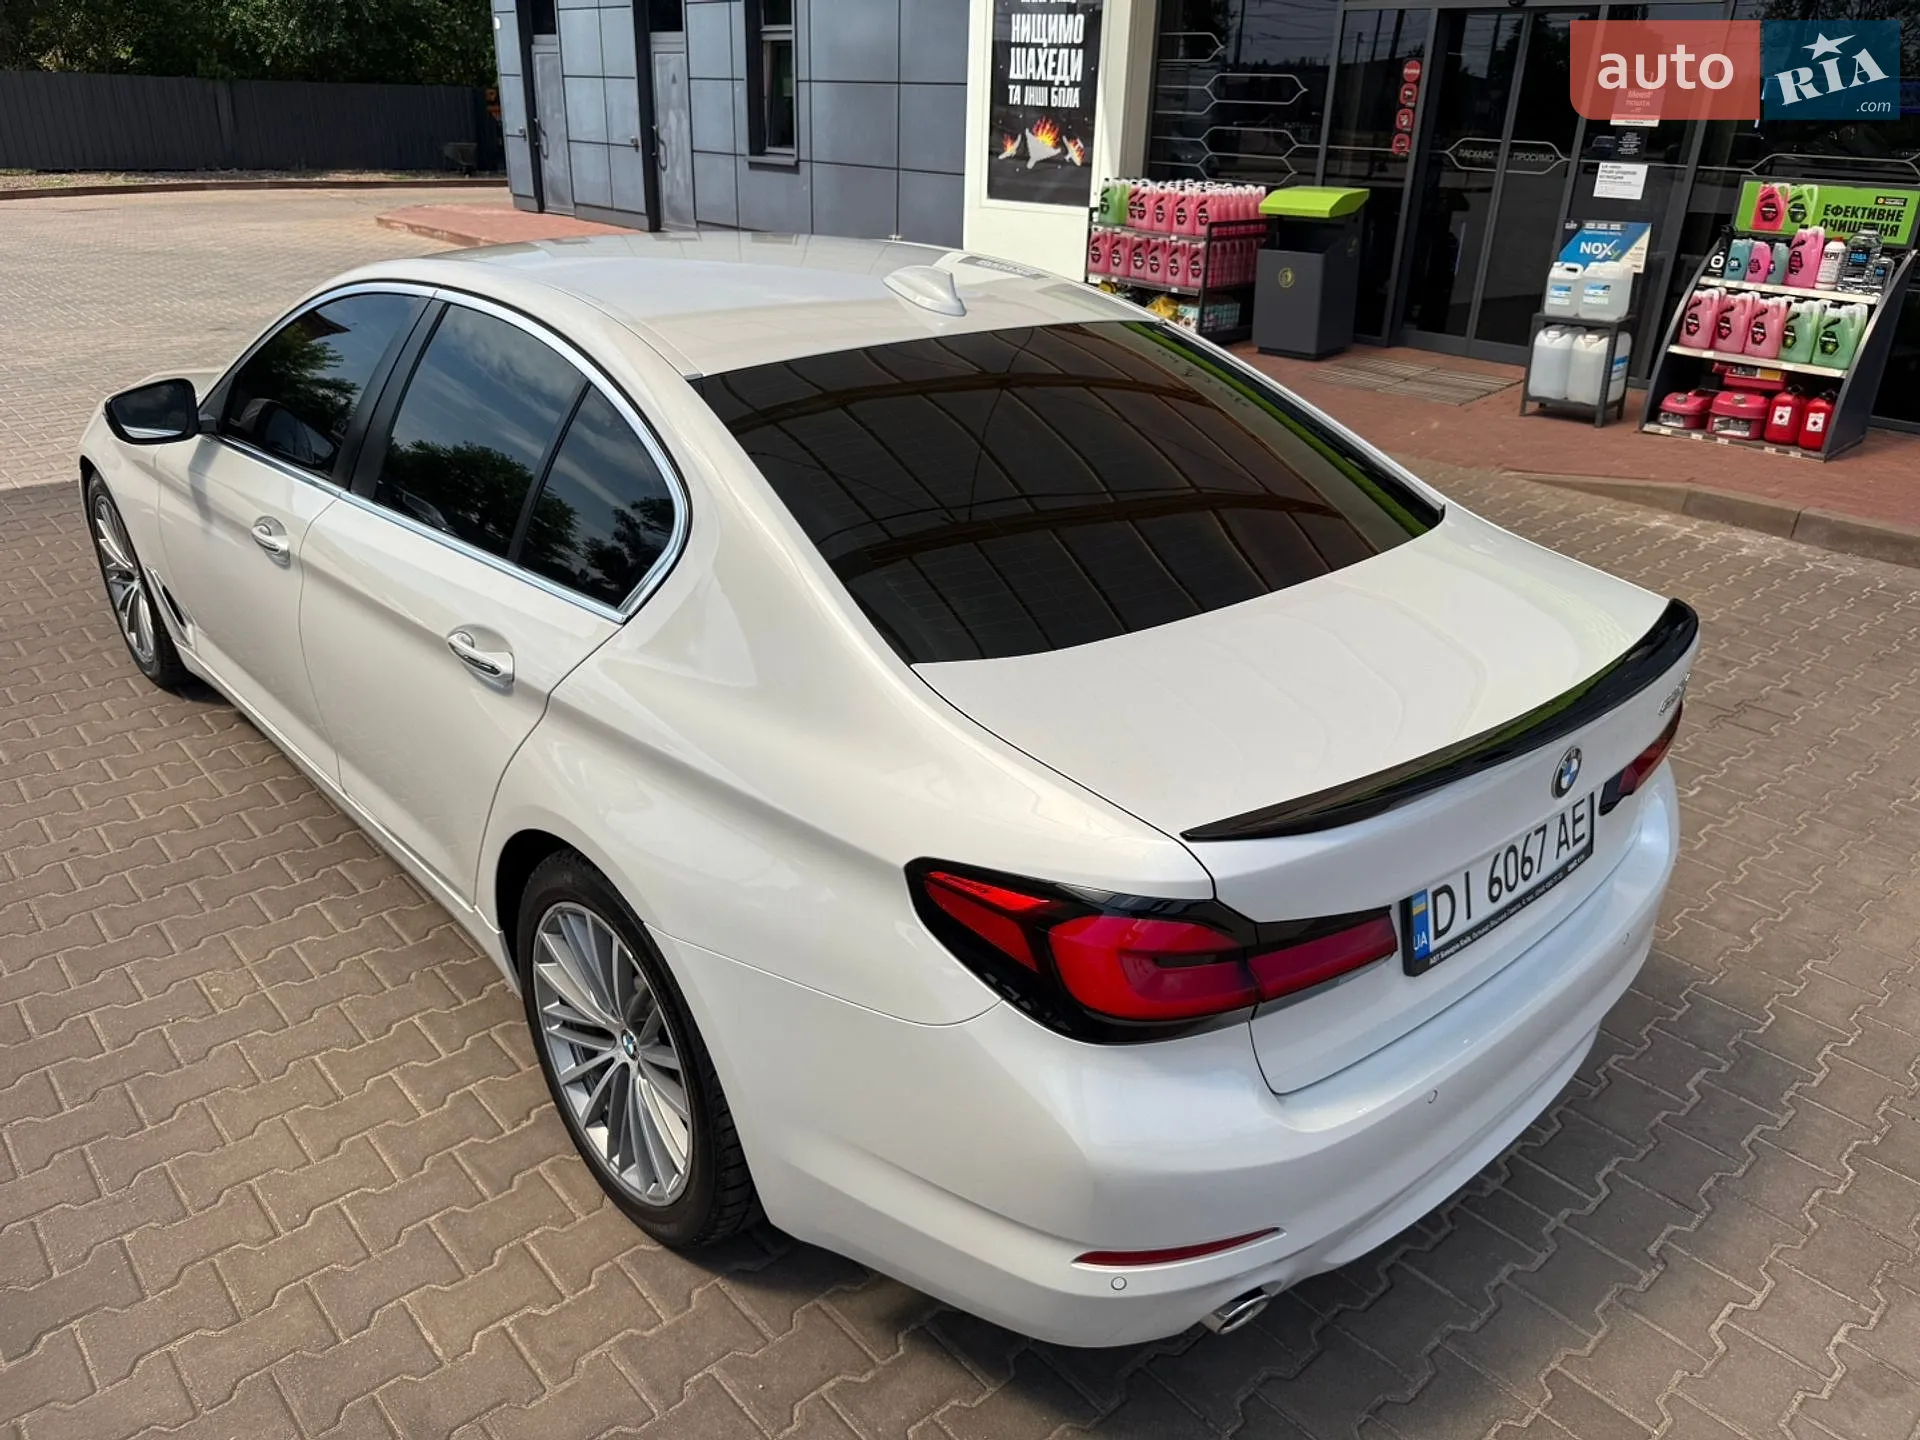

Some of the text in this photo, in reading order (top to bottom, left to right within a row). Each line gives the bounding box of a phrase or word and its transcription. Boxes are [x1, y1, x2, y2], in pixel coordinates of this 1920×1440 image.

[1010, 13, 1085, 48] НИЩИМО
[1008, 47, 1084, 86] ШАХЕДИ
[1008, 84, 1081, 108] ТА ІНШІ БПЛА
[1513, 151, 1555, 163] ПРОСИМО
[1823, 203, 1905, 223] ЕФЕКТИВНЕ
[1431, 871, 1471, 941] DI
[1487, 827, 1549, 905] 6067
[1554, 797, 1586, 861] AE
[1413, 934, 1428, 953] UA
